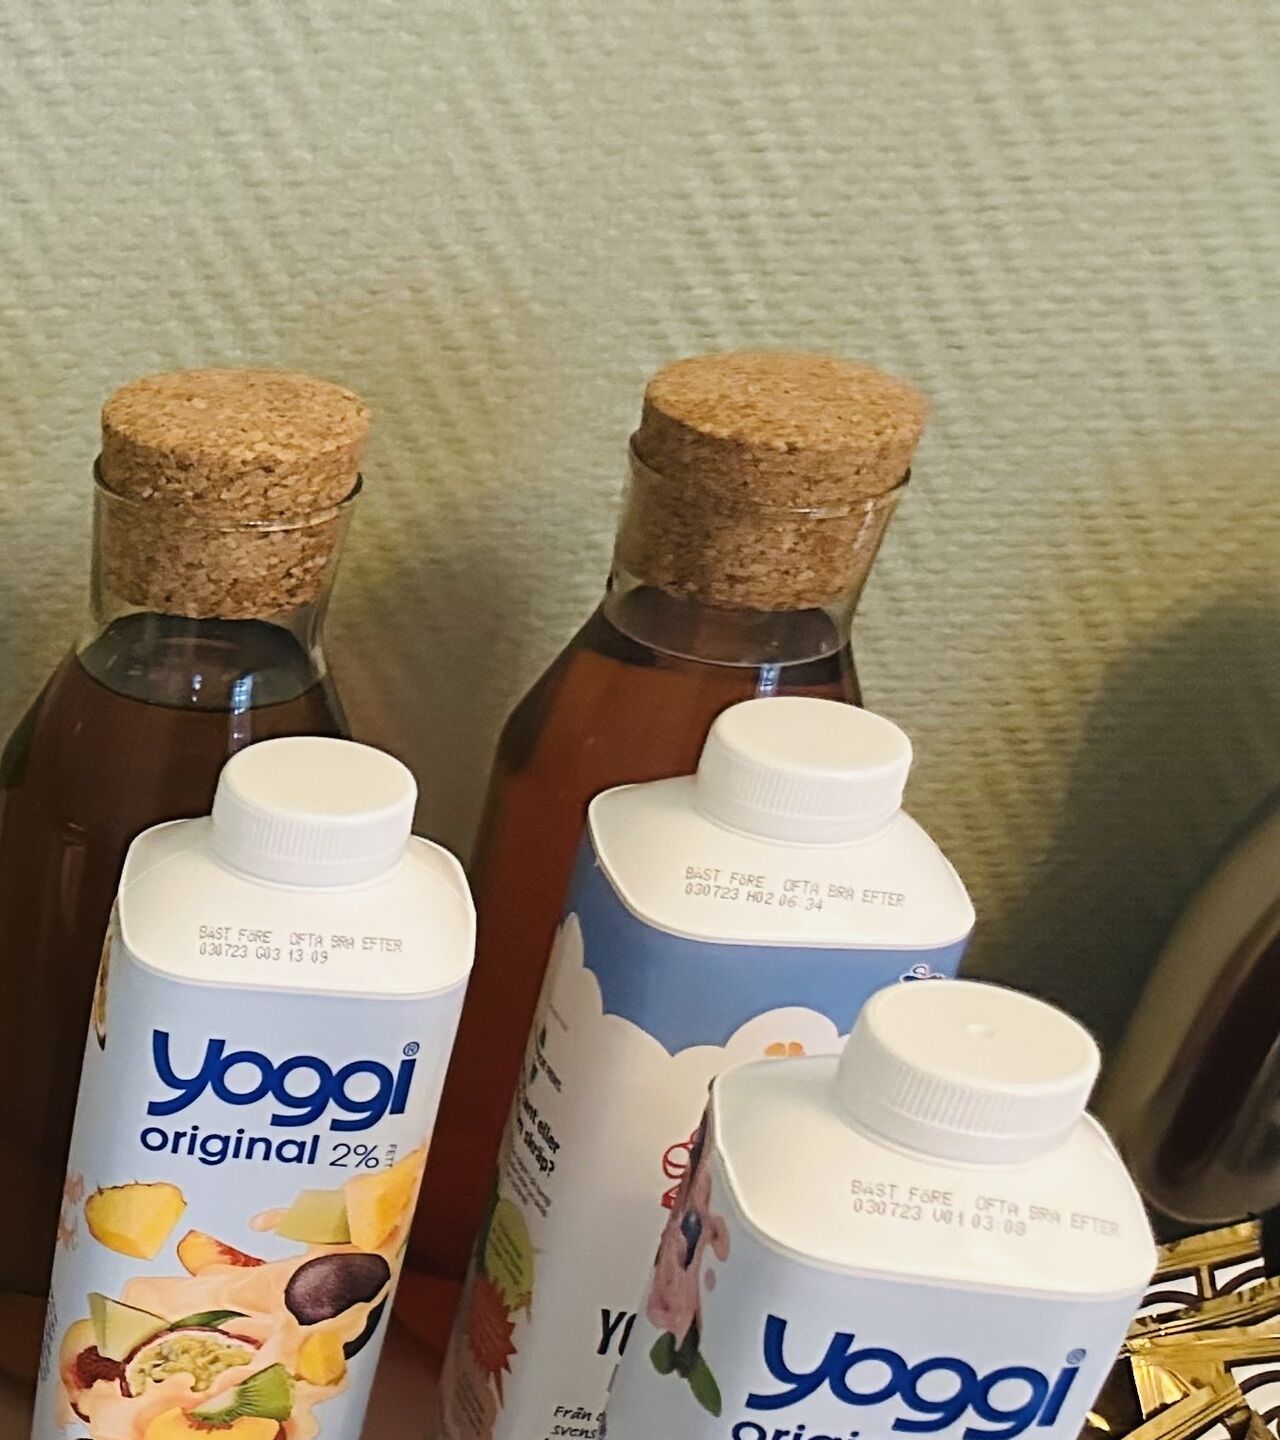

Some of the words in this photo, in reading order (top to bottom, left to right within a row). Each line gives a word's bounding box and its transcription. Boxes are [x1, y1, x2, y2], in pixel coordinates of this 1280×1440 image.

[685, 882, 740, 901] 030723
[862, 888, 906, 908] EFTER
[199, 942, 248, 959] 030723
[362, 936, 404, 953] EFTER
[140, 1126, 320, 1166] original
[329, 1142, 380, 1169] 2%
[853, 1198, 922, 1221] 030723
[553, 1406, 590, 1422] Från
